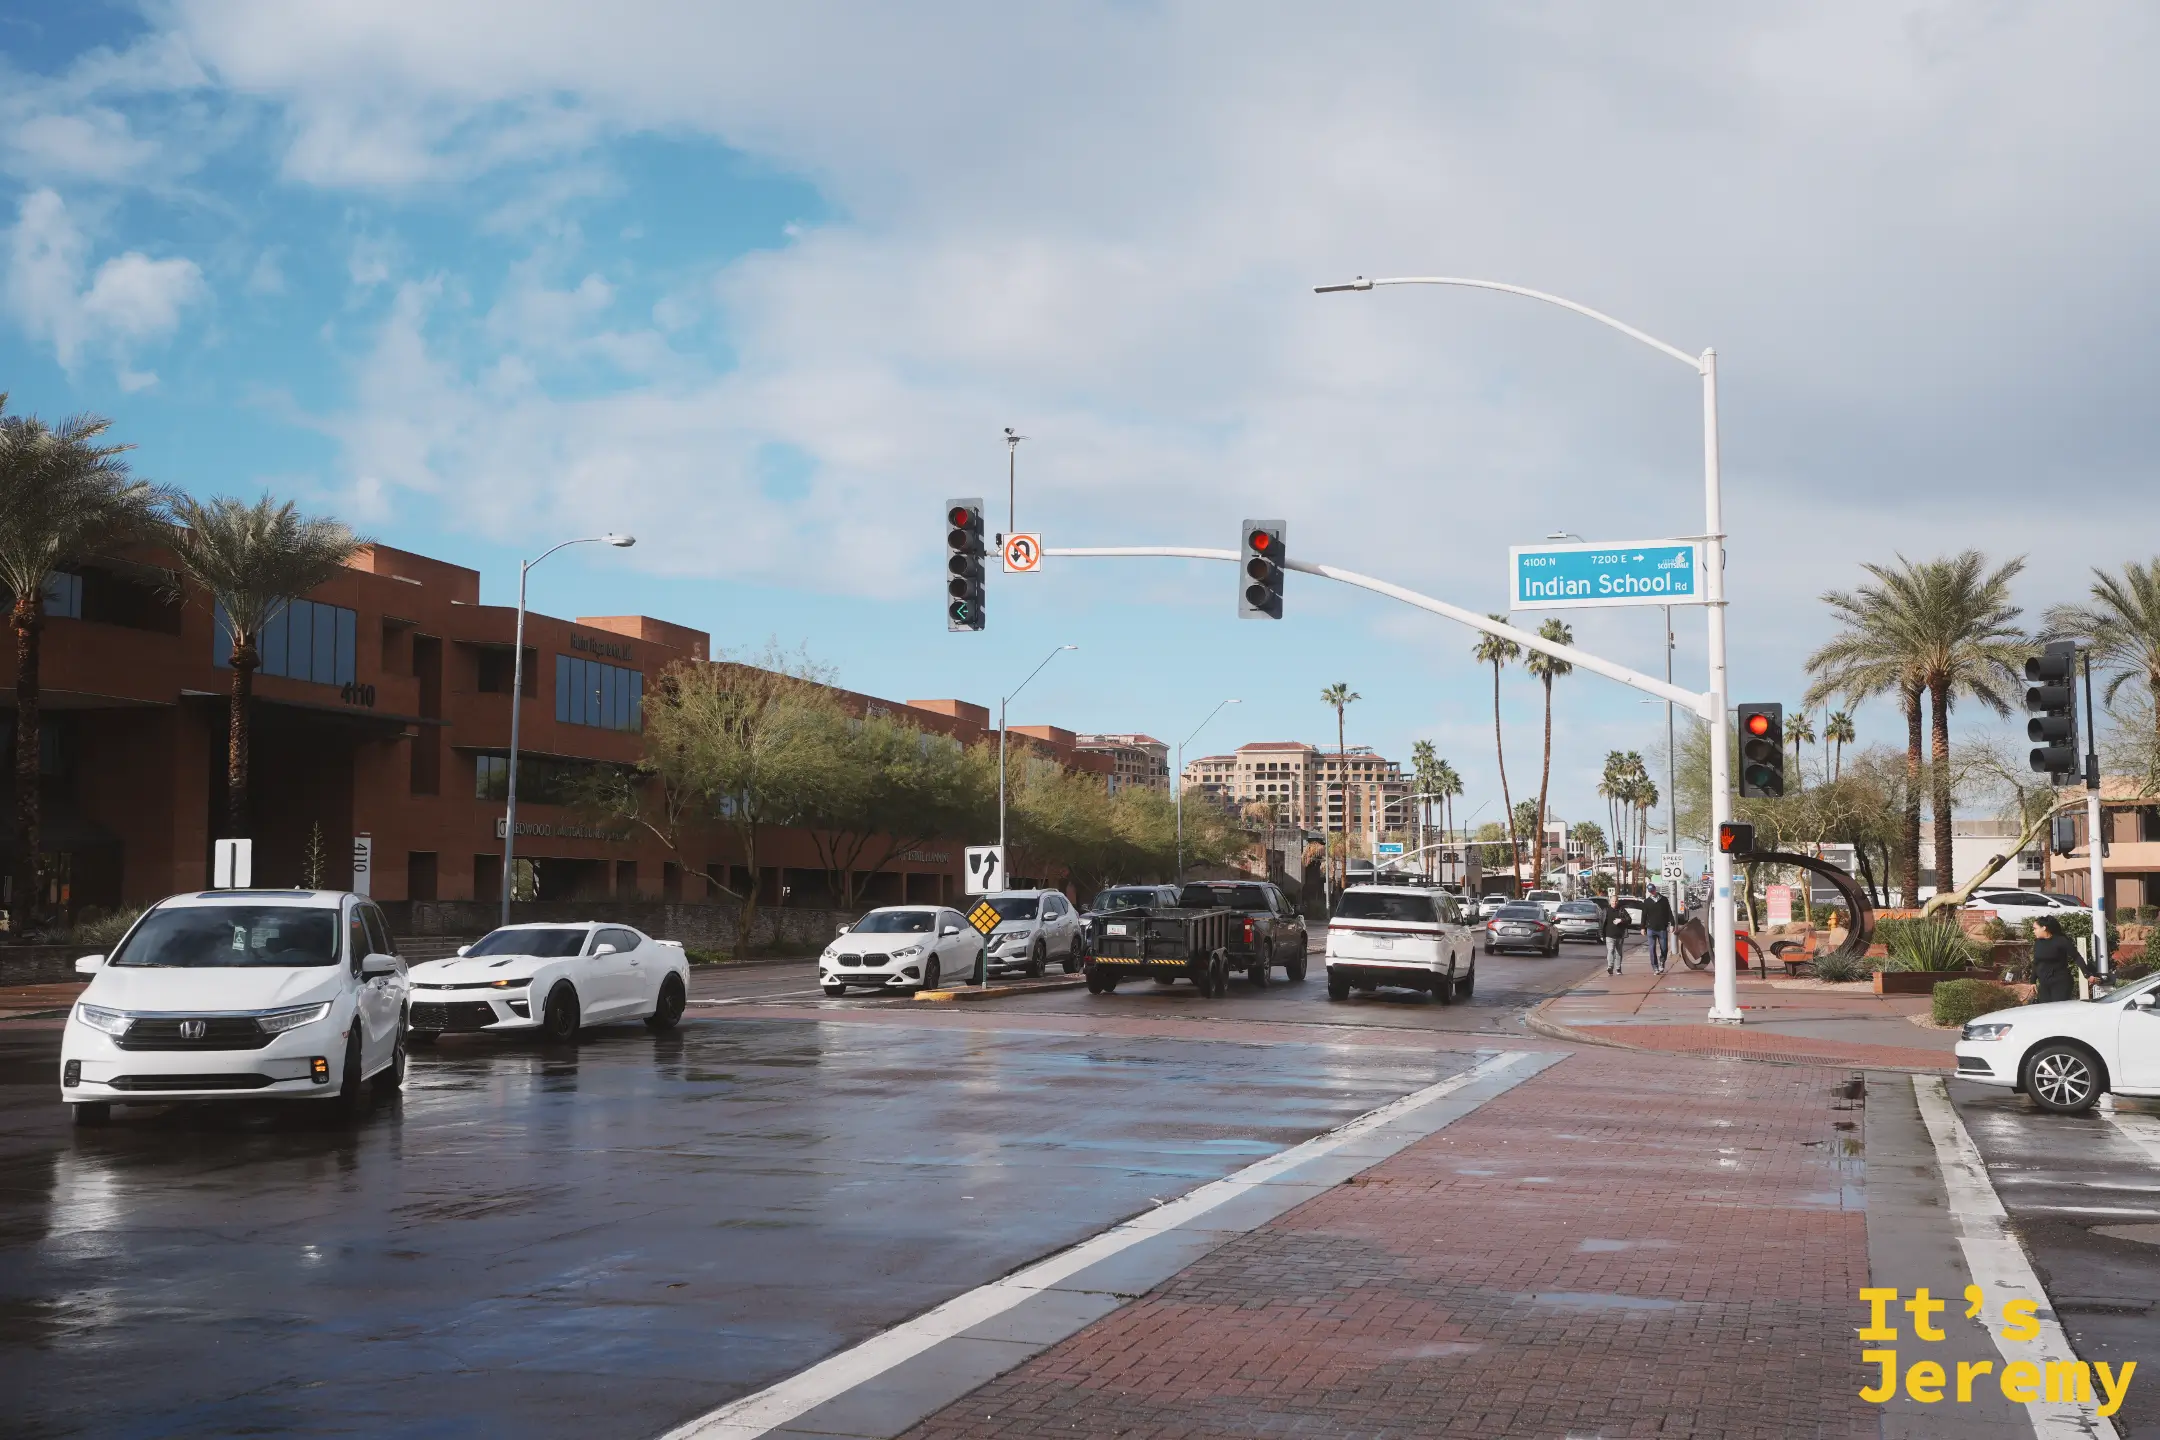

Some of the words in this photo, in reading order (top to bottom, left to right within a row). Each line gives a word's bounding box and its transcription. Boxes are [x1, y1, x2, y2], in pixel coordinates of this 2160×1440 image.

[1523, 557, 1547, 567] 4100
[1549, 557, 1556, 566] N
[1591, 554, 1618, 564] 7200
[1621, 554, 1628, 563] E
[1525, 576, 1591, 597] Indian
[1598, 571, 1671, 594] School
[1675, 582, 1687, 591] Rd
[341, 681, 376, 708] 4110
[513, 822, 551, 836] EDWOOD
[353, 843, 368, 872] 4110
[1664, 867, 1682, 877] 30
